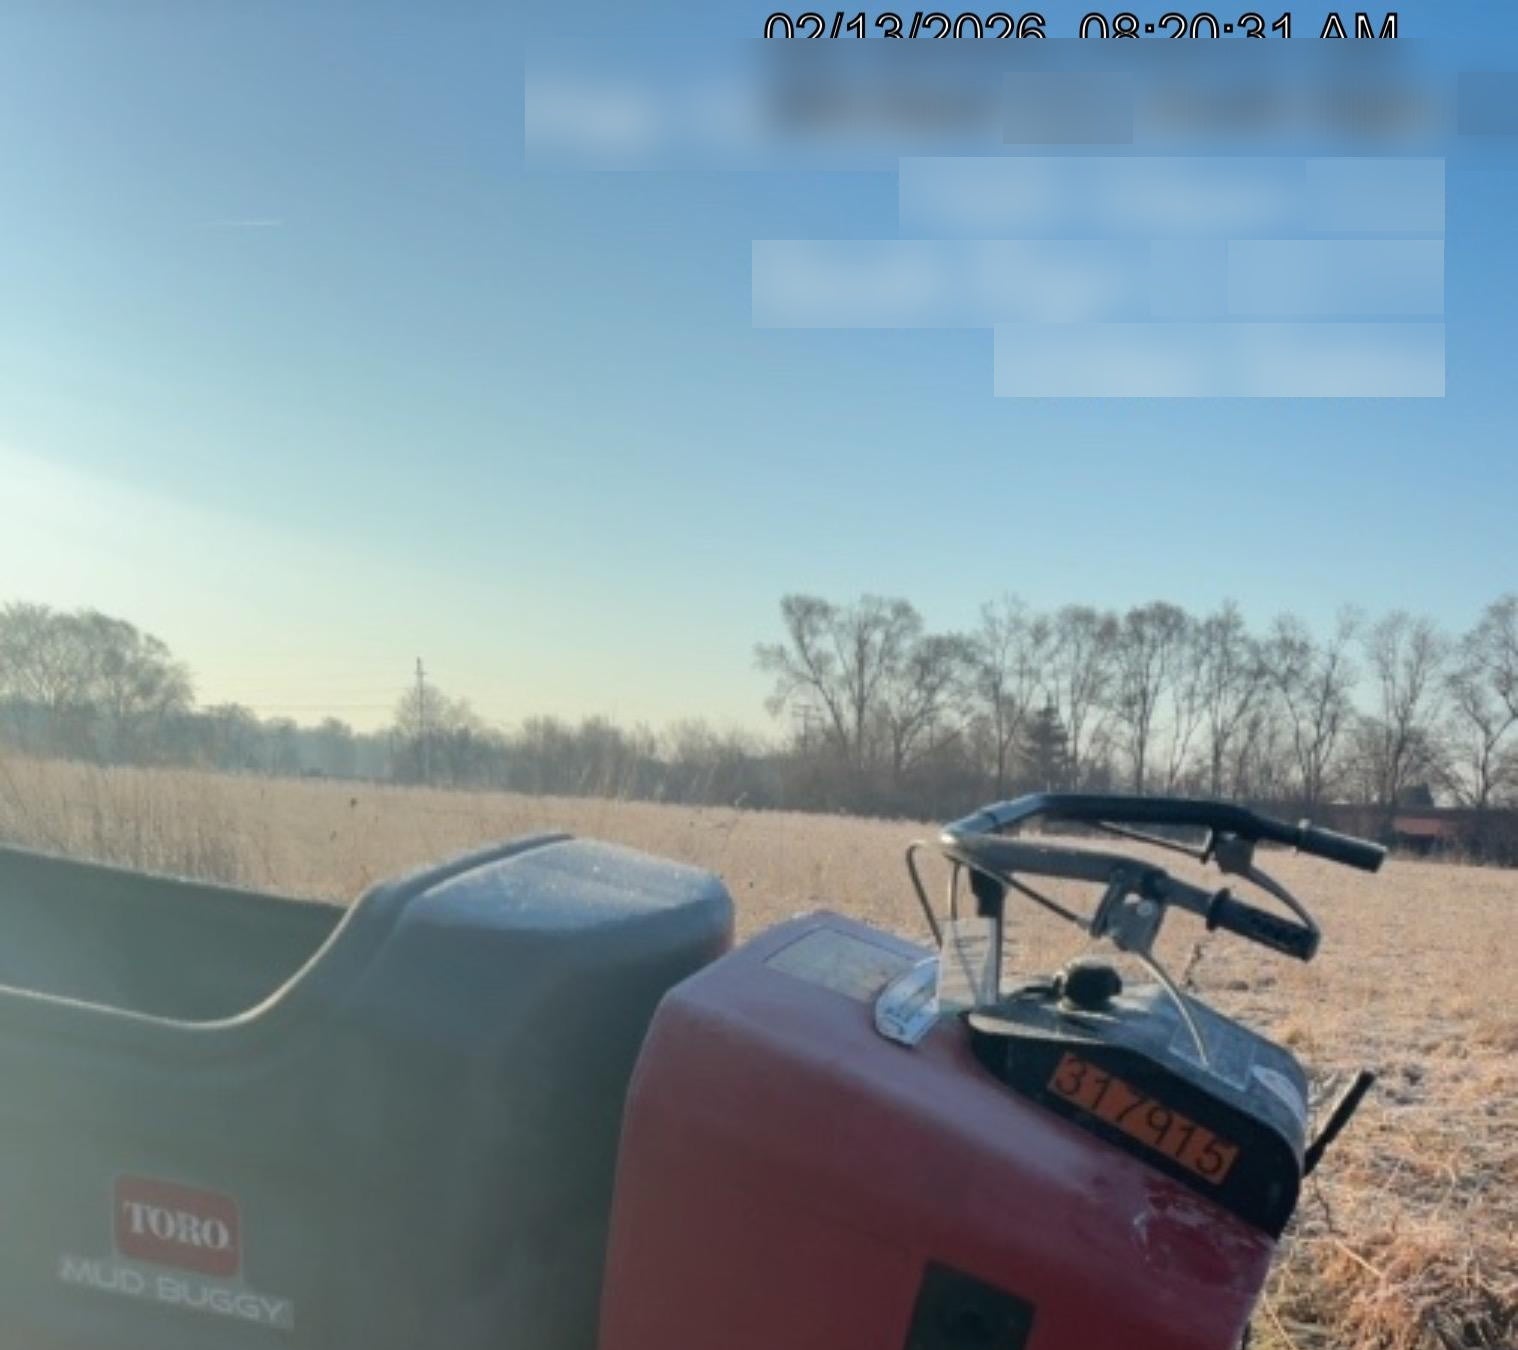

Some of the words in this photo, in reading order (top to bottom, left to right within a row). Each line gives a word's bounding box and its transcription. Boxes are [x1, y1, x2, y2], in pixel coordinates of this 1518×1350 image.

[1054, 1056, 1232, 1176] 317915
[122, 1201, 231, 1250] TORO
[59, 1253, 145, 1295] MUD
[156, 1275, 285, 1323] BUGGY
